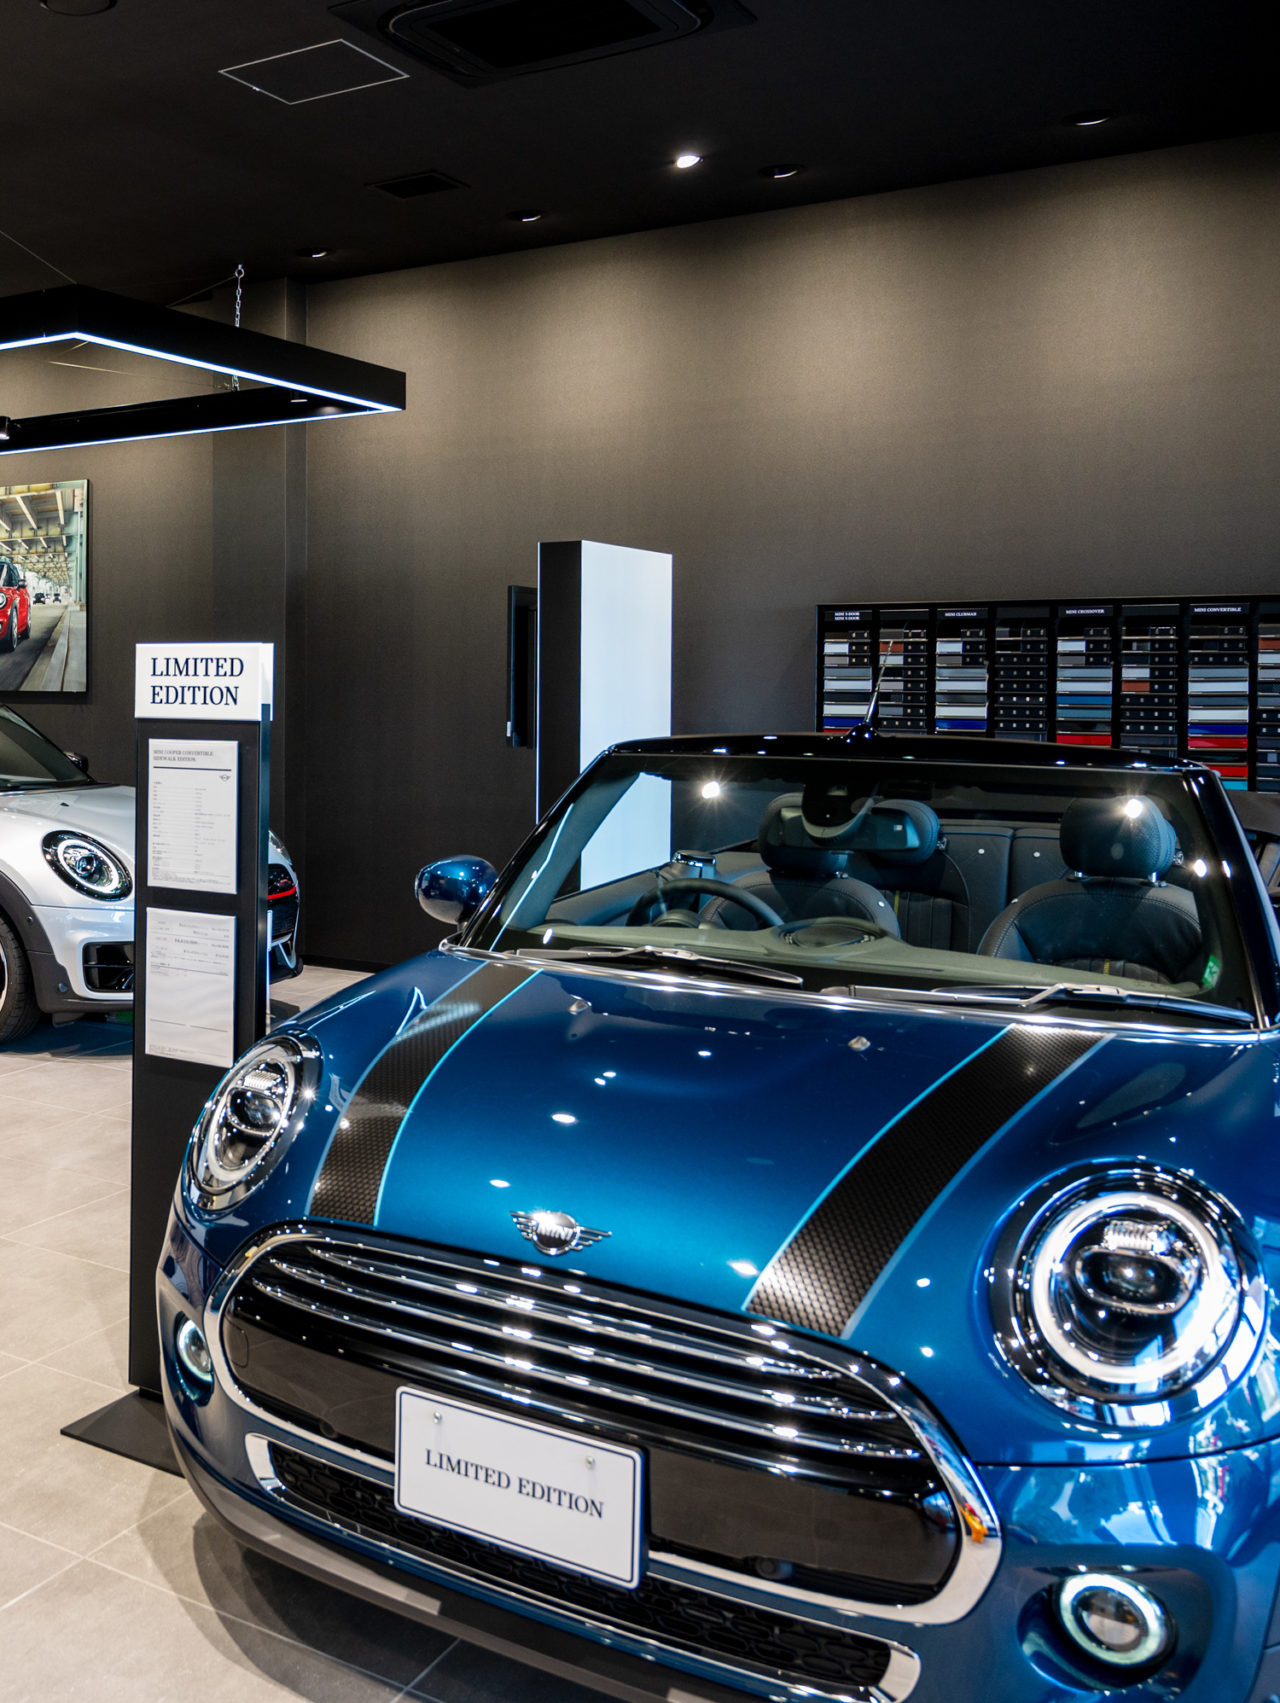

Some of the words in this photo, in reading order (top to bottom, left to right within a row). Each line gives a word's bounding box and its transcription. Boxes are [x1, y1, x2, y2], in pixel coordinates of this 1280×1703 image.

[151, 657, 244, 677] LIMITED
[150, 685, 239, 705] EDITION
[425, 1448, 511, 1490] LIMITED
[517, 1476, 604, 1519] EDITION
